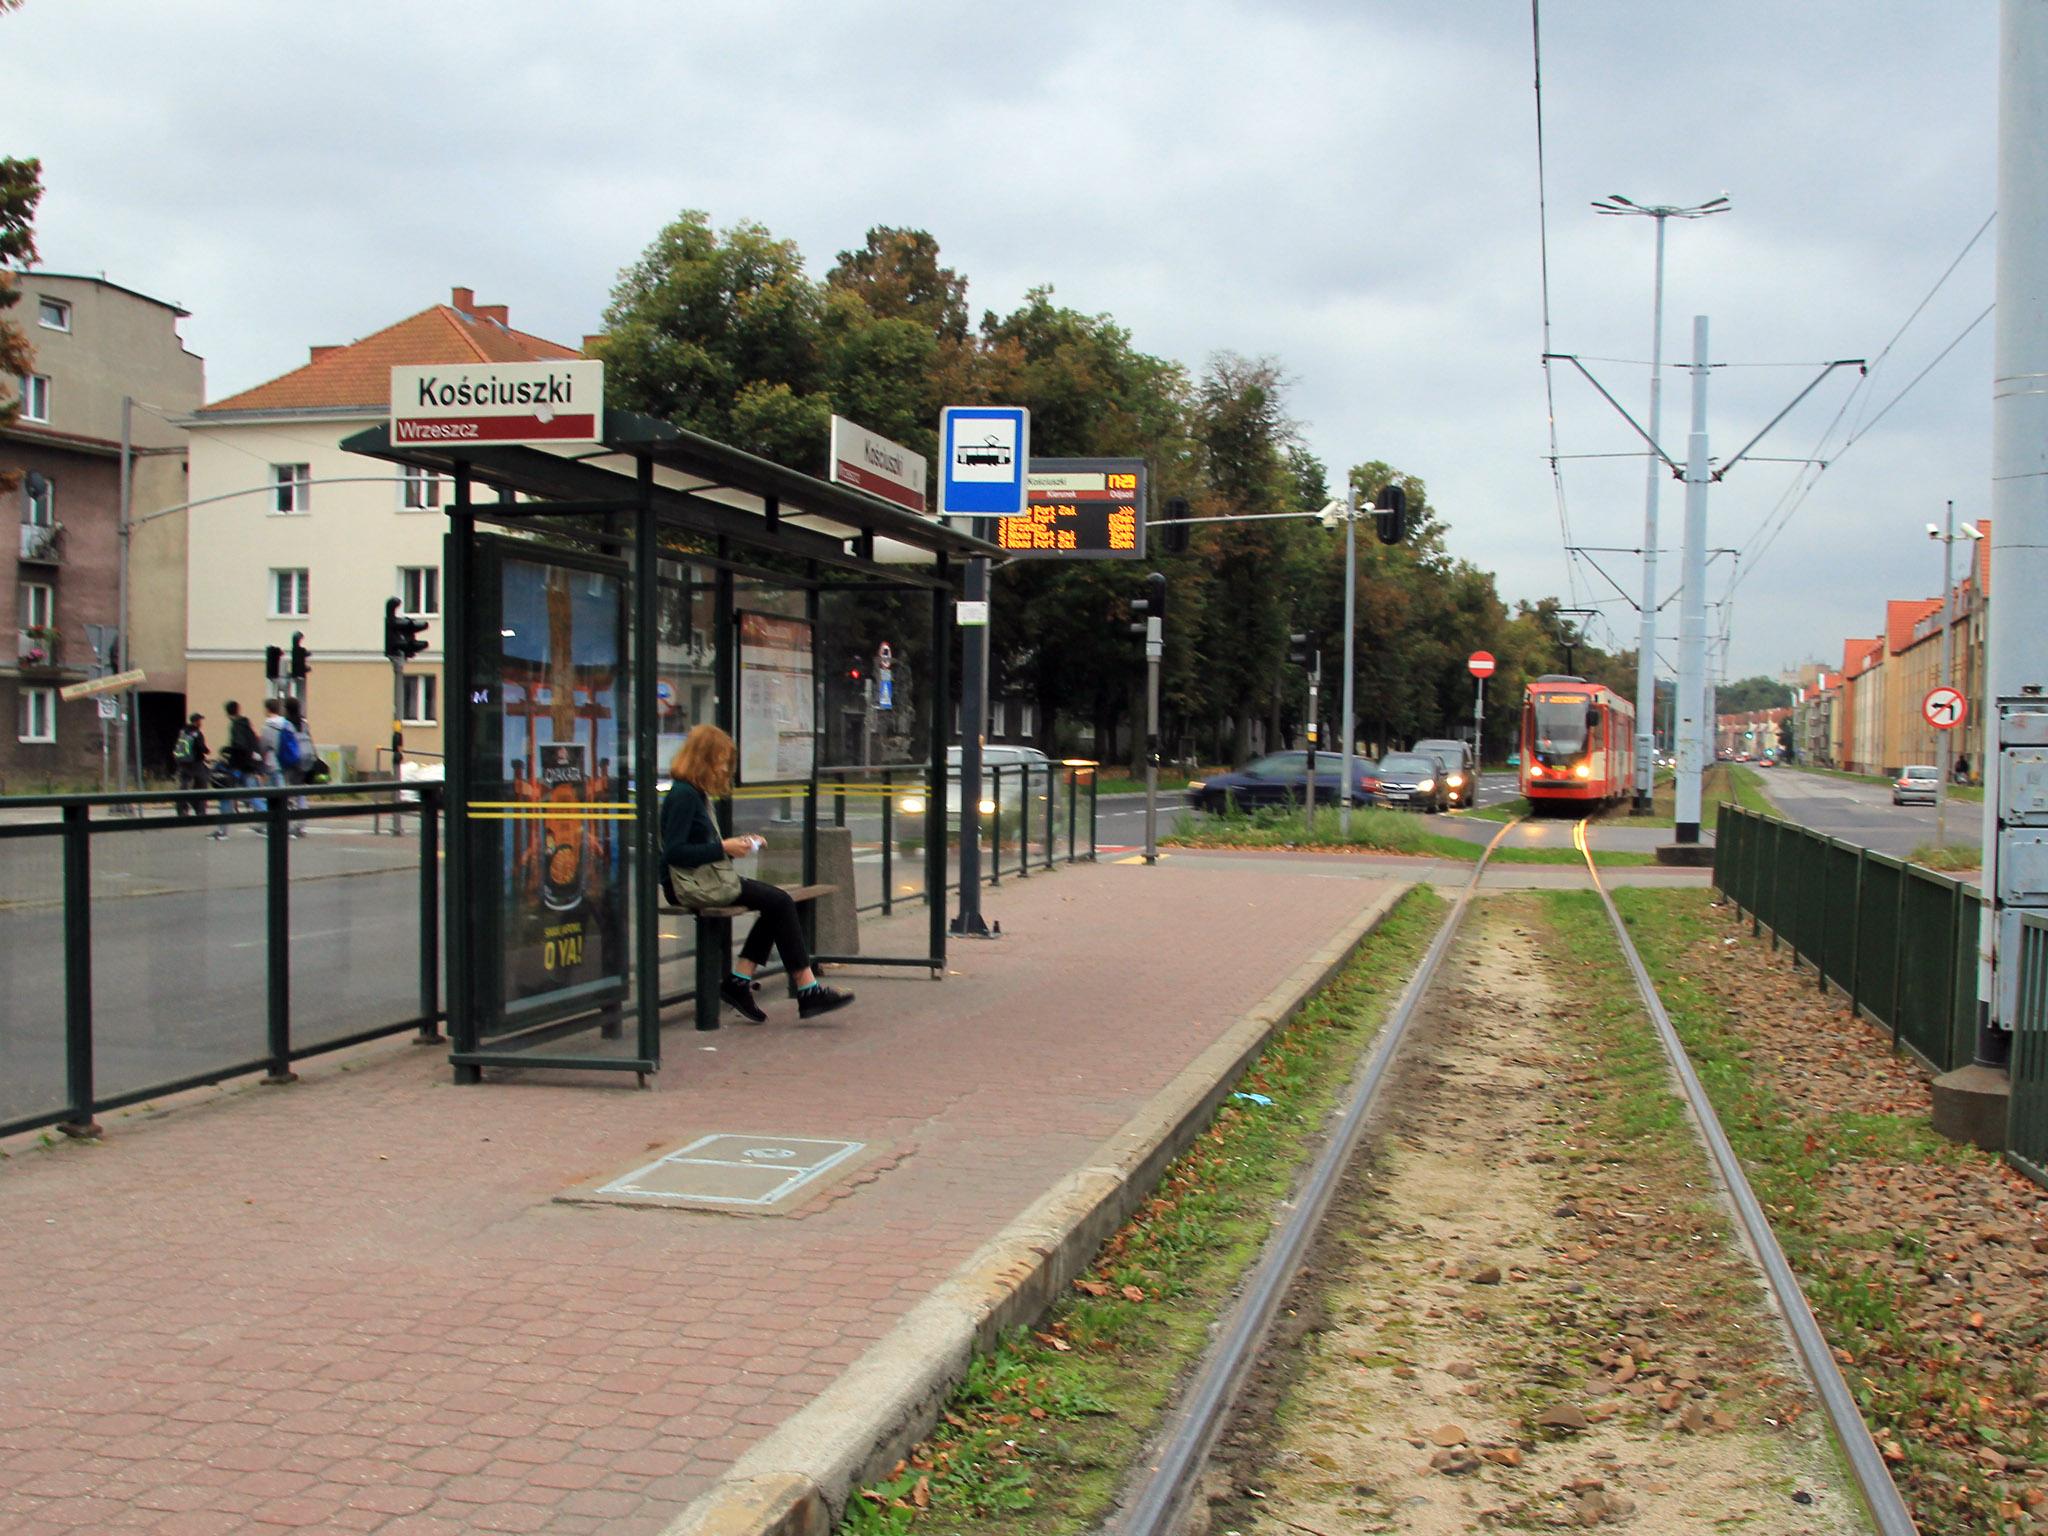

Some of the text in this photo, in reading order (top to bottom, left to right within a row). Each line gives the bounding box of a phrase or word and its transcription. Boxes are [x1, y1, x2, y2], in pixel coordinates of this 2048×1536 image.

[419, 374, 572, 406] Kościuszki
[399, 421, 479, 439] Wrzeszcz
[544, 935, 583, 971] O YA!
